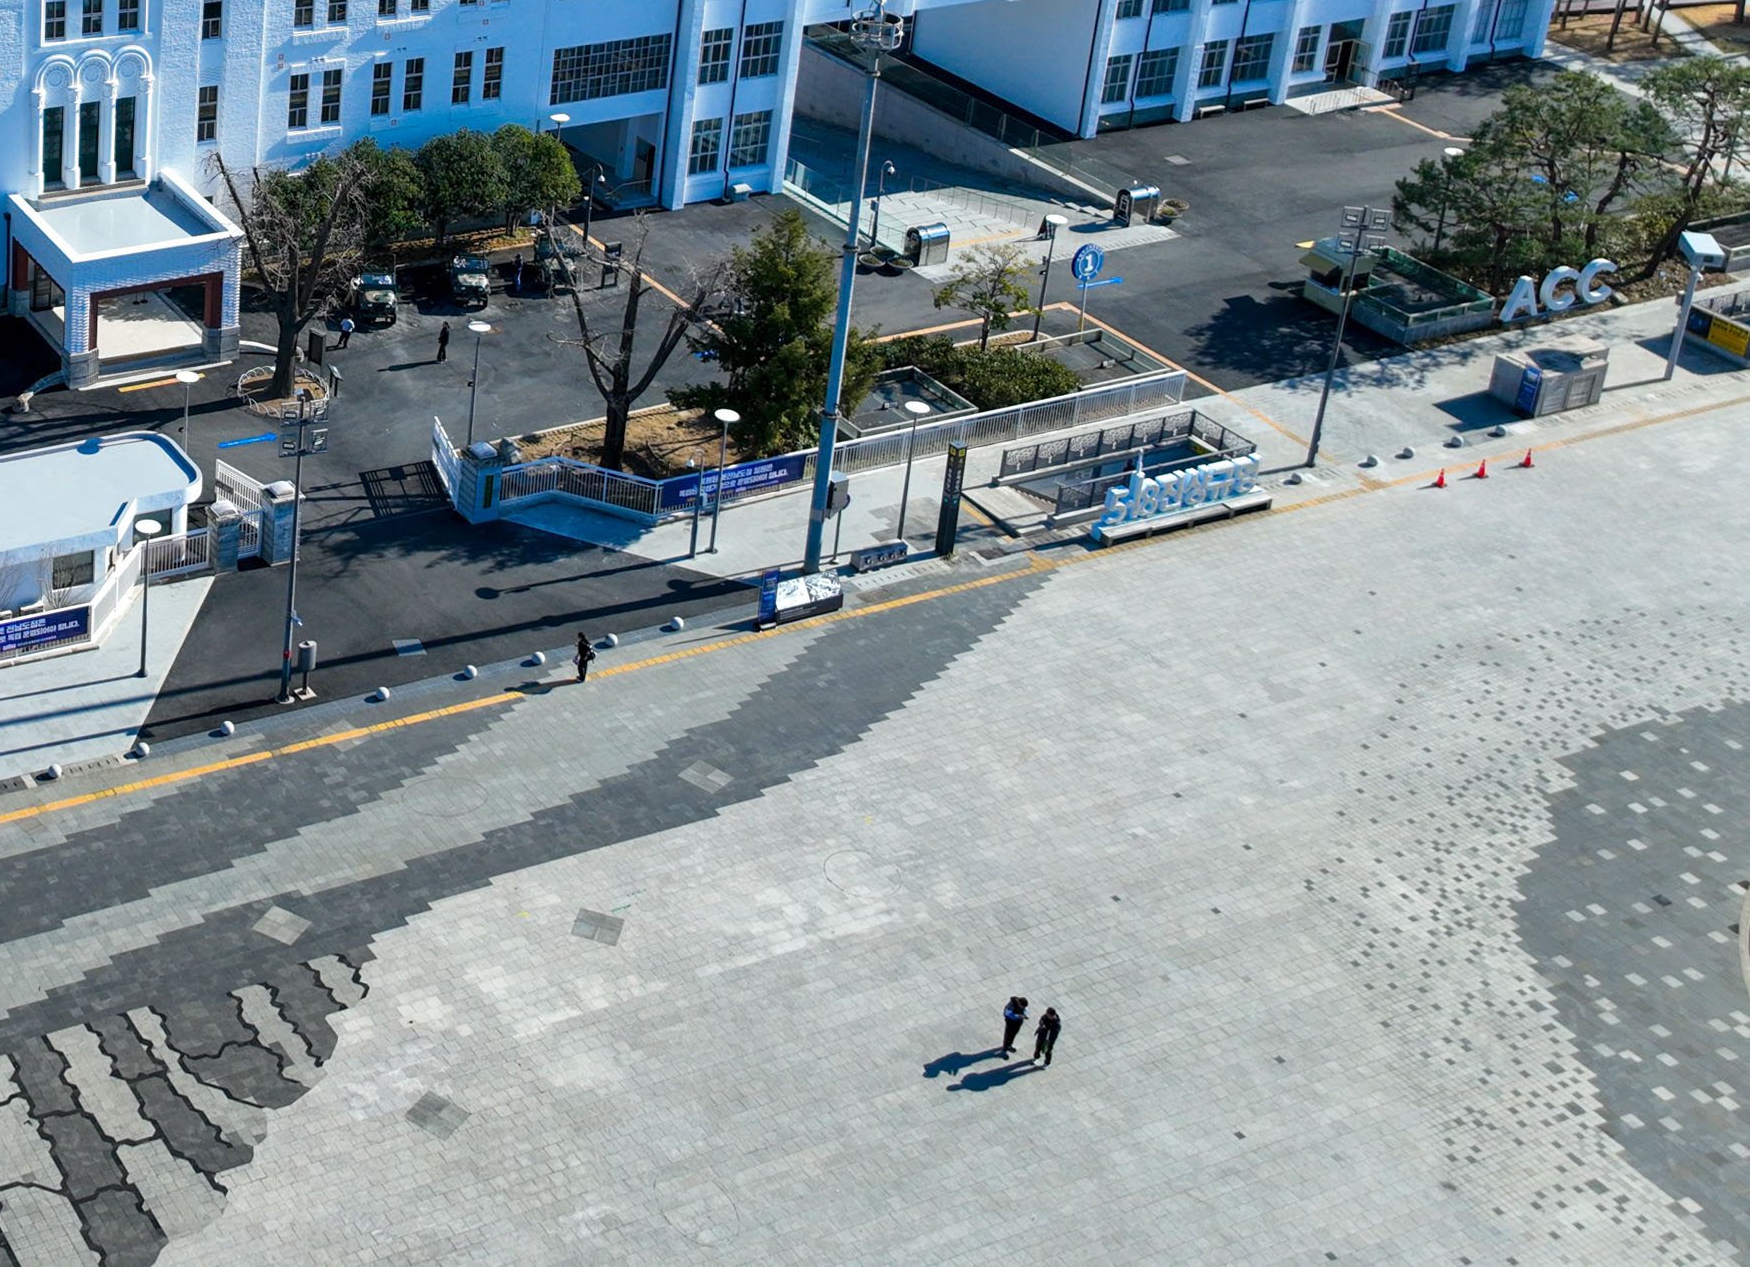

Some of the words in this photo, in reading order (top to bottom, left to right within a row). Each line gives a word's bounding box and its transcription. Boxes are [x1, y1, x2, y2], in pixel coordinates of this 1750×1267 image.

[1084, 254, 1093, 271] 1
[1499, 258, 1618, 322] ACC
[7, 618, 46, 634] 전남도청은
[22, 627, 57, 639] 운영되어야
